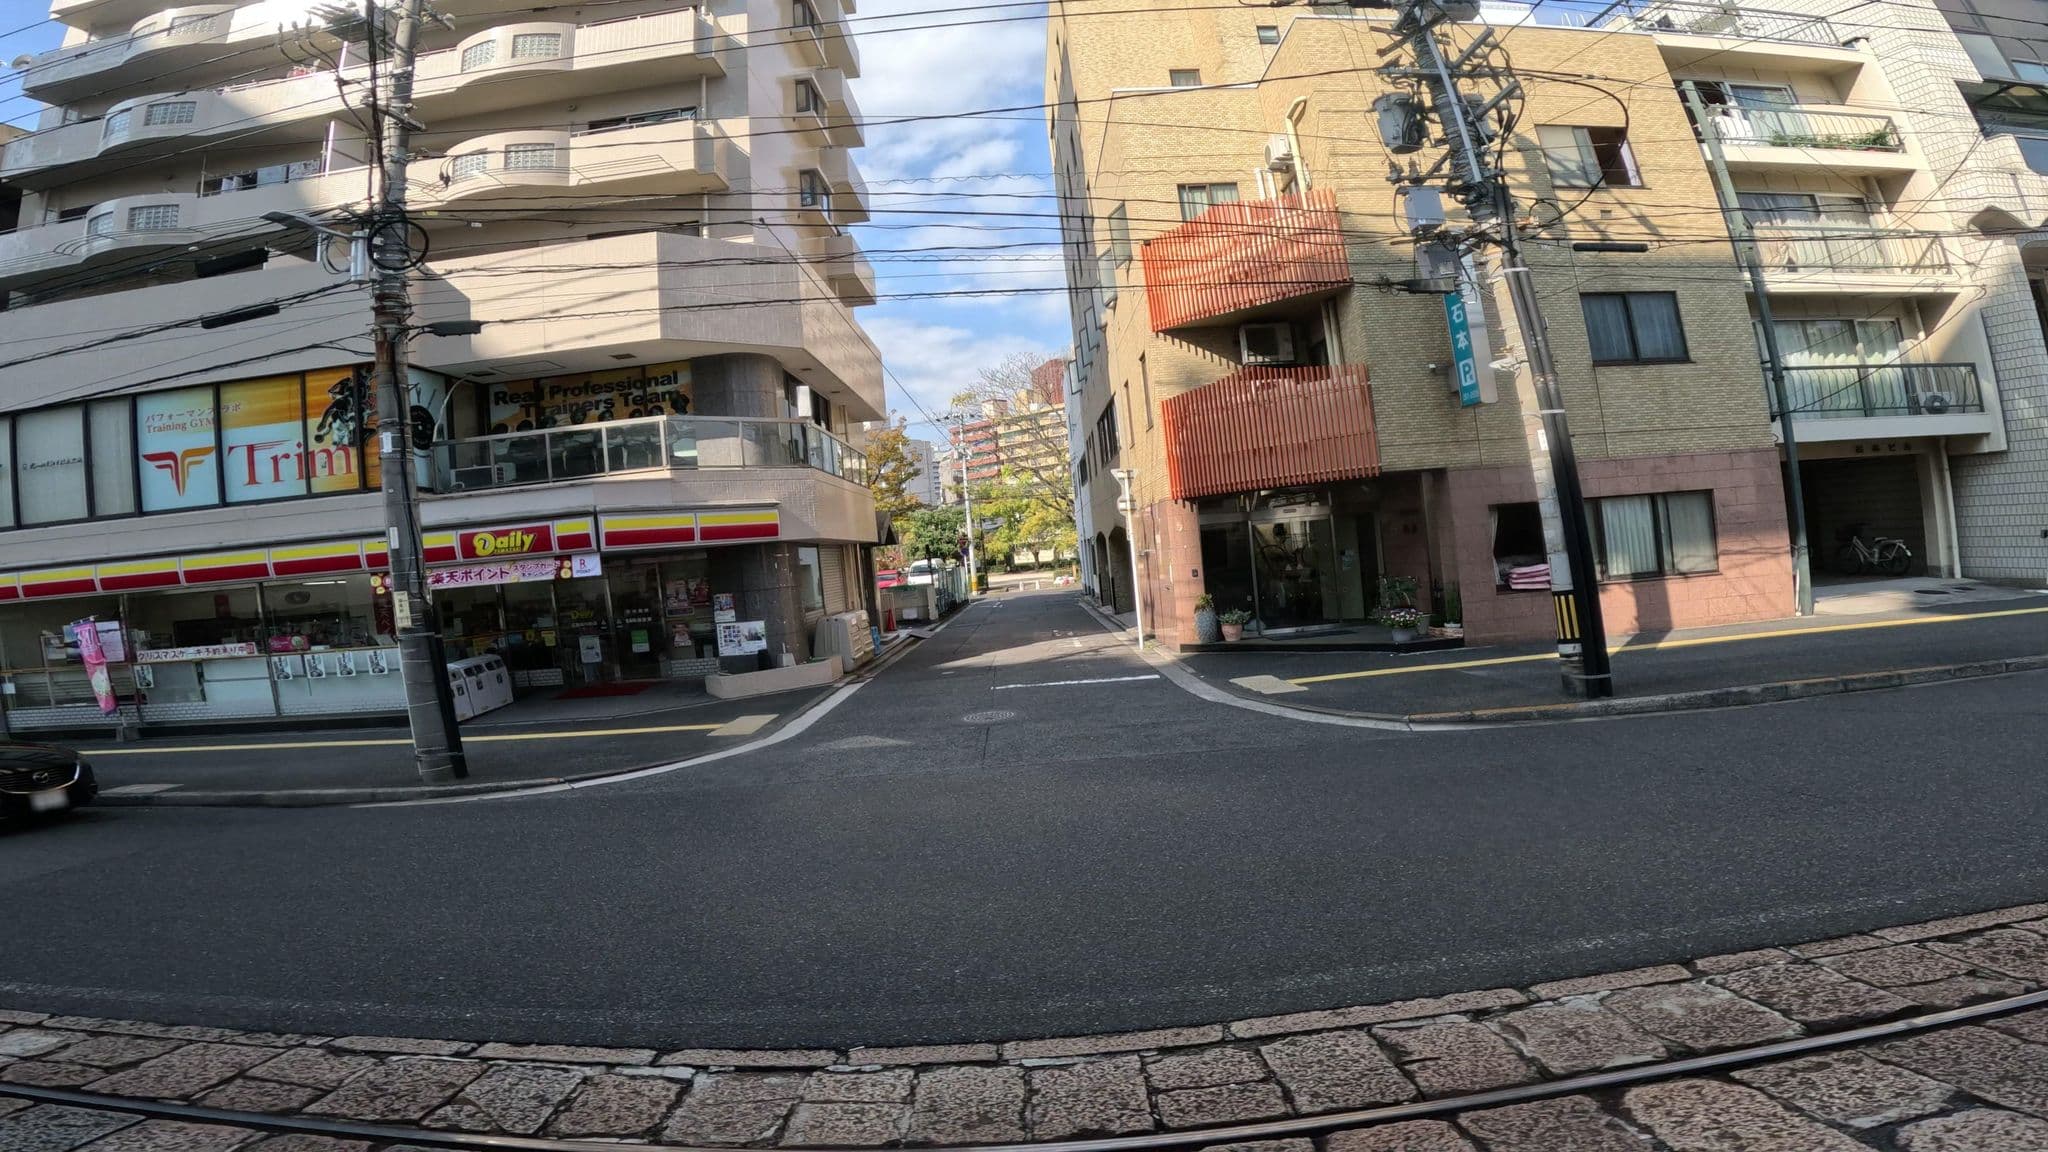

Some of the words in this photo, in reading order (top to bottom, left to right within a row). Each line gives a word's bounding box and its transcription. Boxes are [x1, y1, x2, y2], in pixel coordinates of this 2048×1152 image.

[550, 371, 678, 397] Professional
[147, 422, 187, 433] Training
[227, 439, 354, 486] Trim
[473, 531, 536, 555] Daily
[431, 567, 510, 585] 楽天ポイント
